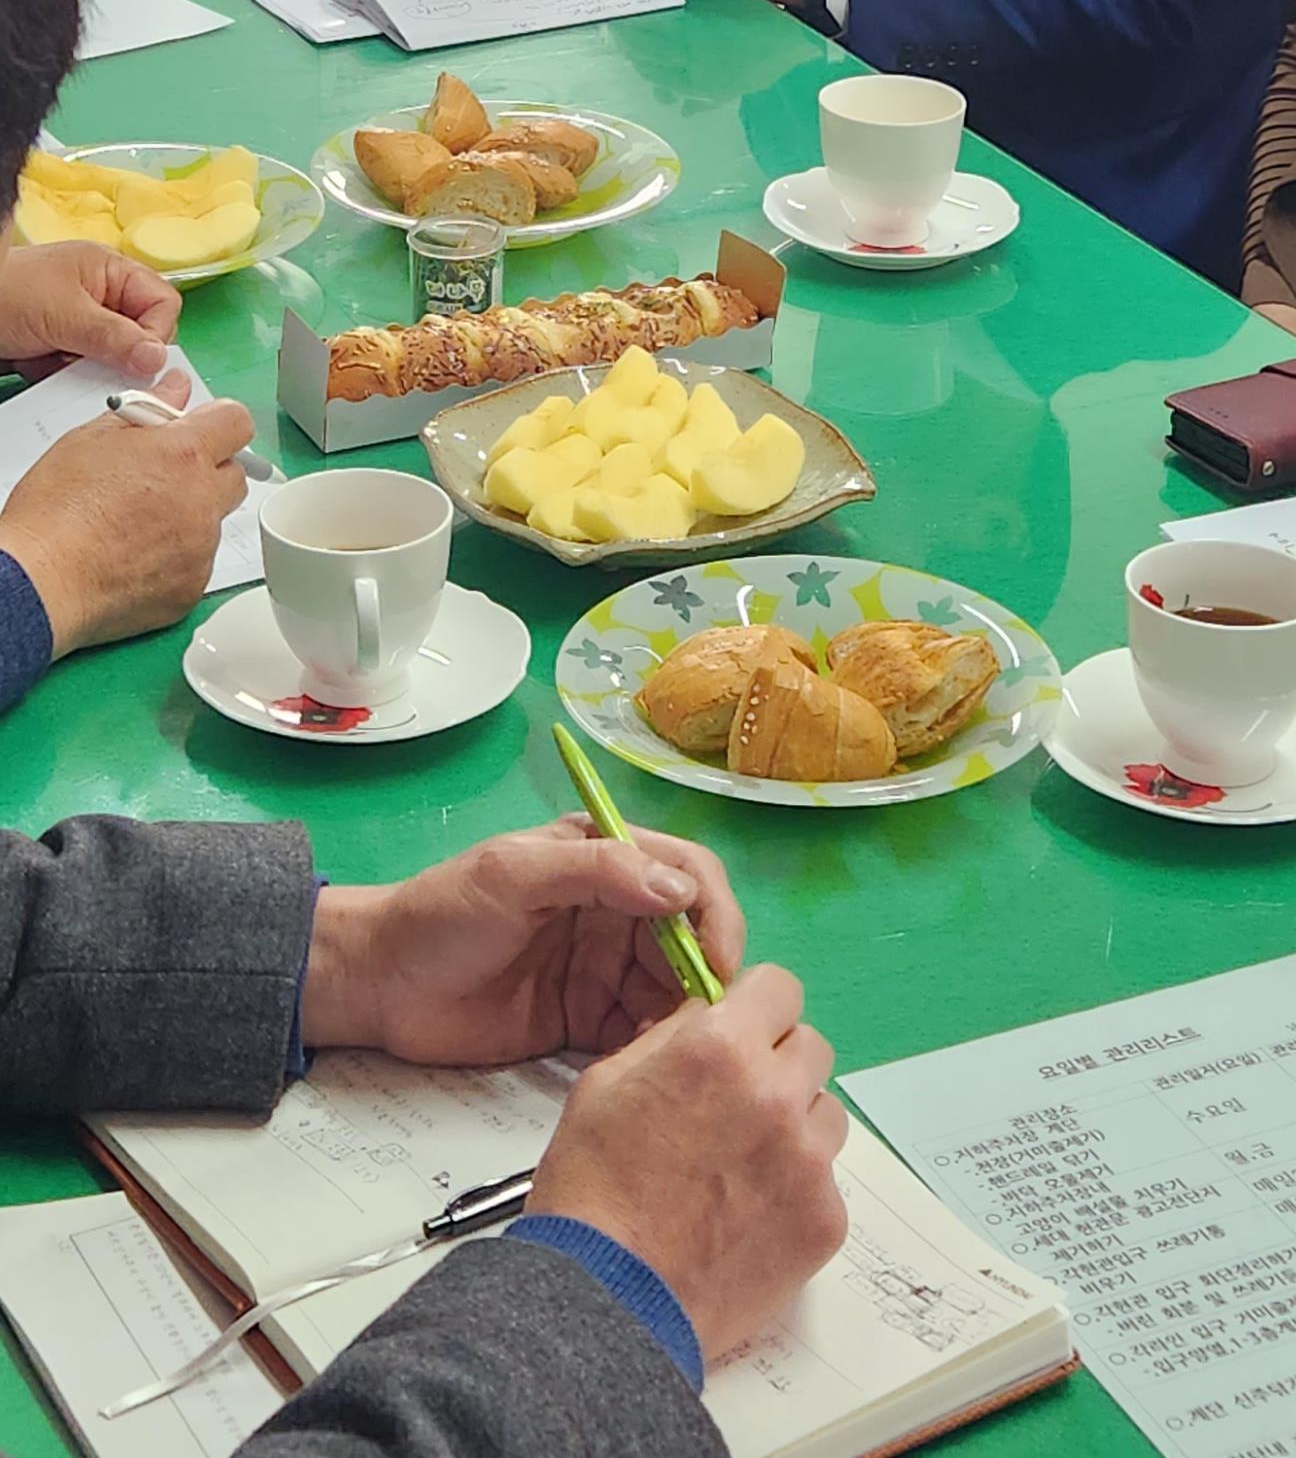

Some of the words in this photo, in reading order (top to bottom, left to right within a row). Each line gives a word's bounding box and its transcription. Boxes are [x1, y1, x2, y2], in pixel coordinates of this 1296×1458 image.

[1038, 1053, 1100, 1079] 요일별
[1102, 1025, 1202, 1063] 관리리스트
[1008, 1103, 1078, 1131] 관리장소
[1185, 1096, 1248, 1124] 수요일
[1046, 1117, 1081, 1137] 계단
[1014, 1211, 1072, 1237] 고양이
[1156, 1223, 1227, 1254] 쓰레기통
[1079, 1270, 1138, 1296] 비우기
[1155, 1278, 1192, 1302] 입구
[1190, 1317, 1228, 1342] 입구
